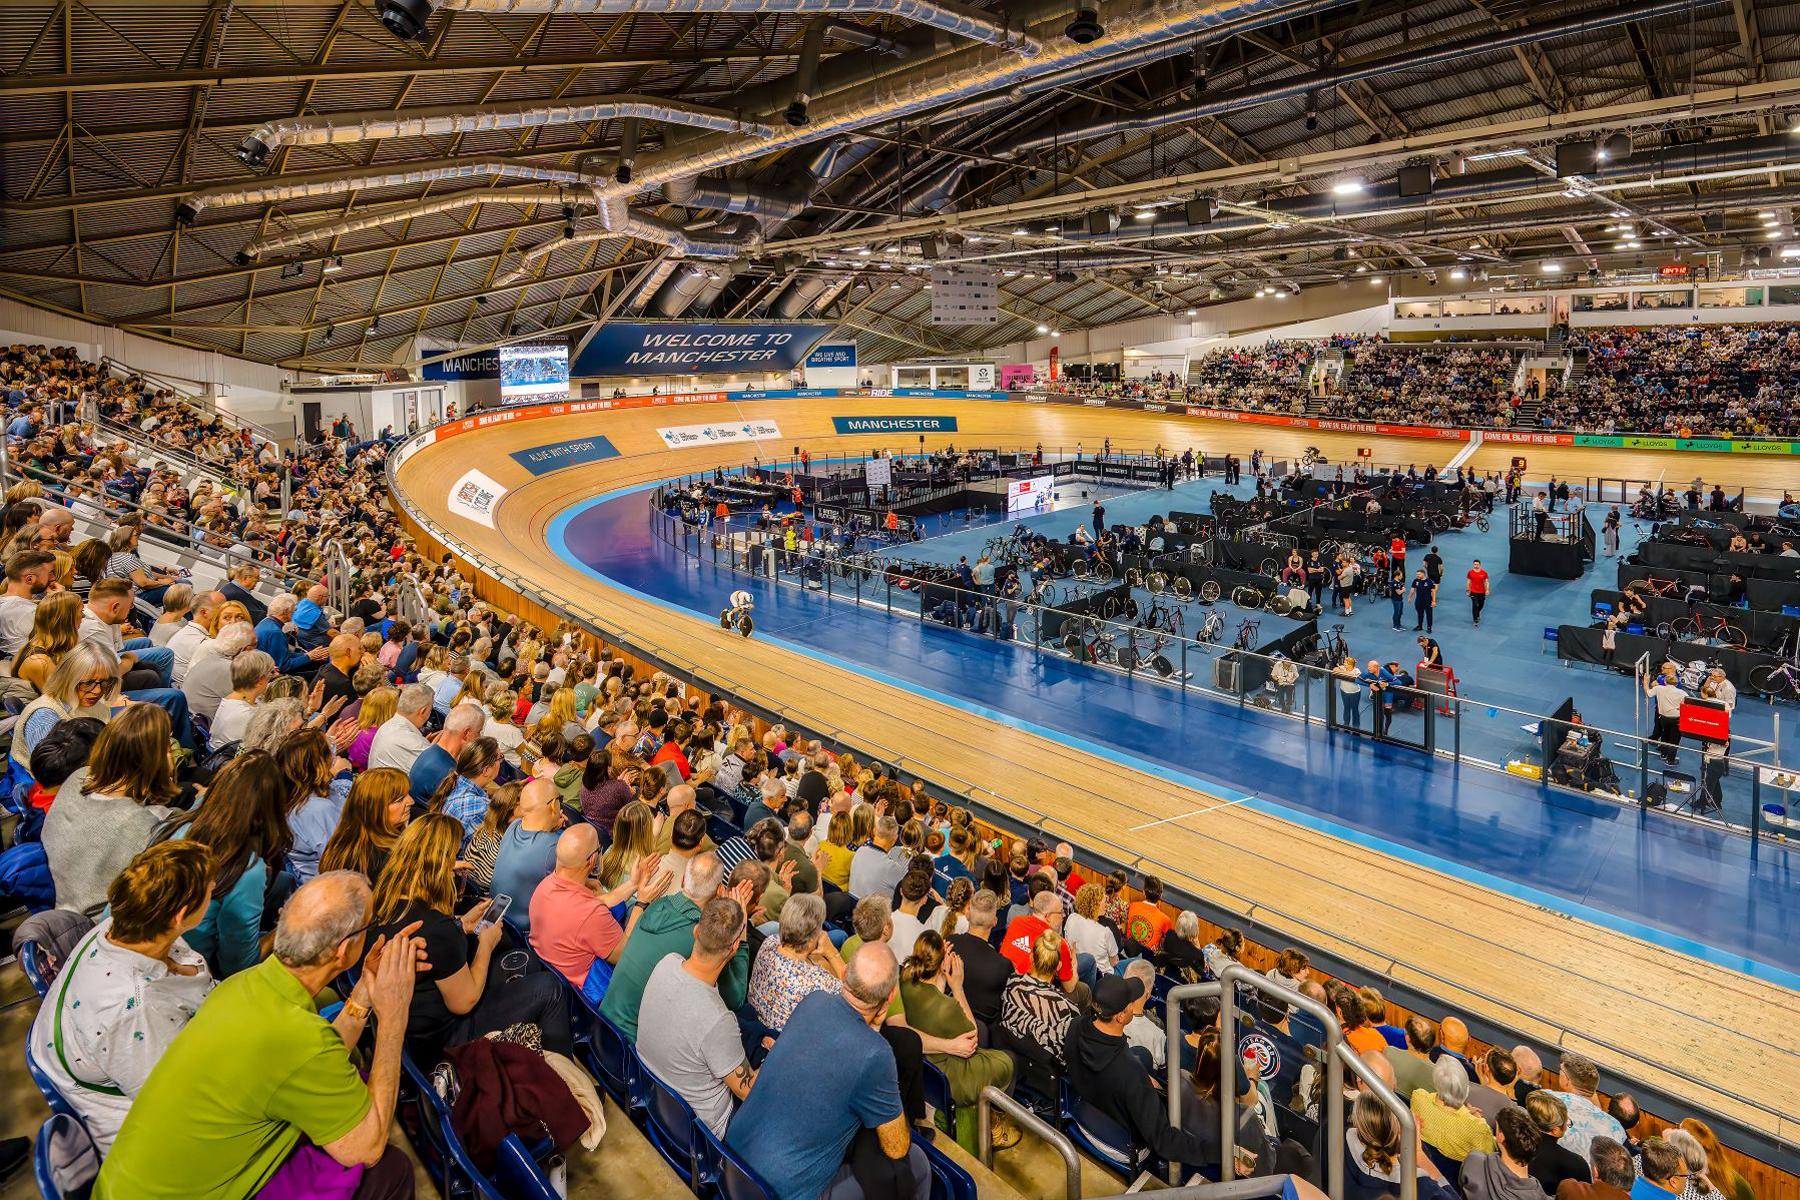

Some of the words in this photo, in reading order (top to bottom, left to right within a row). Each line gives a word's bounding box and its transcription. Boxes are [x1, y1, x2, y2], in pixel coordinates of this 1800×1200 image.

[643, 334, 760, 348] WELCOME
[765, 333, 792, 346] TO
[625, 349, 777, 364] MANCHESTER
[442, 357, 499, 373] MANCHES
[870, 389, 893, 397] RIDE
[848, 420, 940, 430] MANCHESTER
[1512, 434, 1530, 442] ENJOY
[1544, 436, 1557, 444] RIDE
[528, 451, 552, 462] ALIVE
[550, 446, 572, 458] WITH
[569, 442, 596, 454] SPORT
[1011, 940, 1032, 954] adidas
[1246, 1037, 1265, 1045] TEAM
